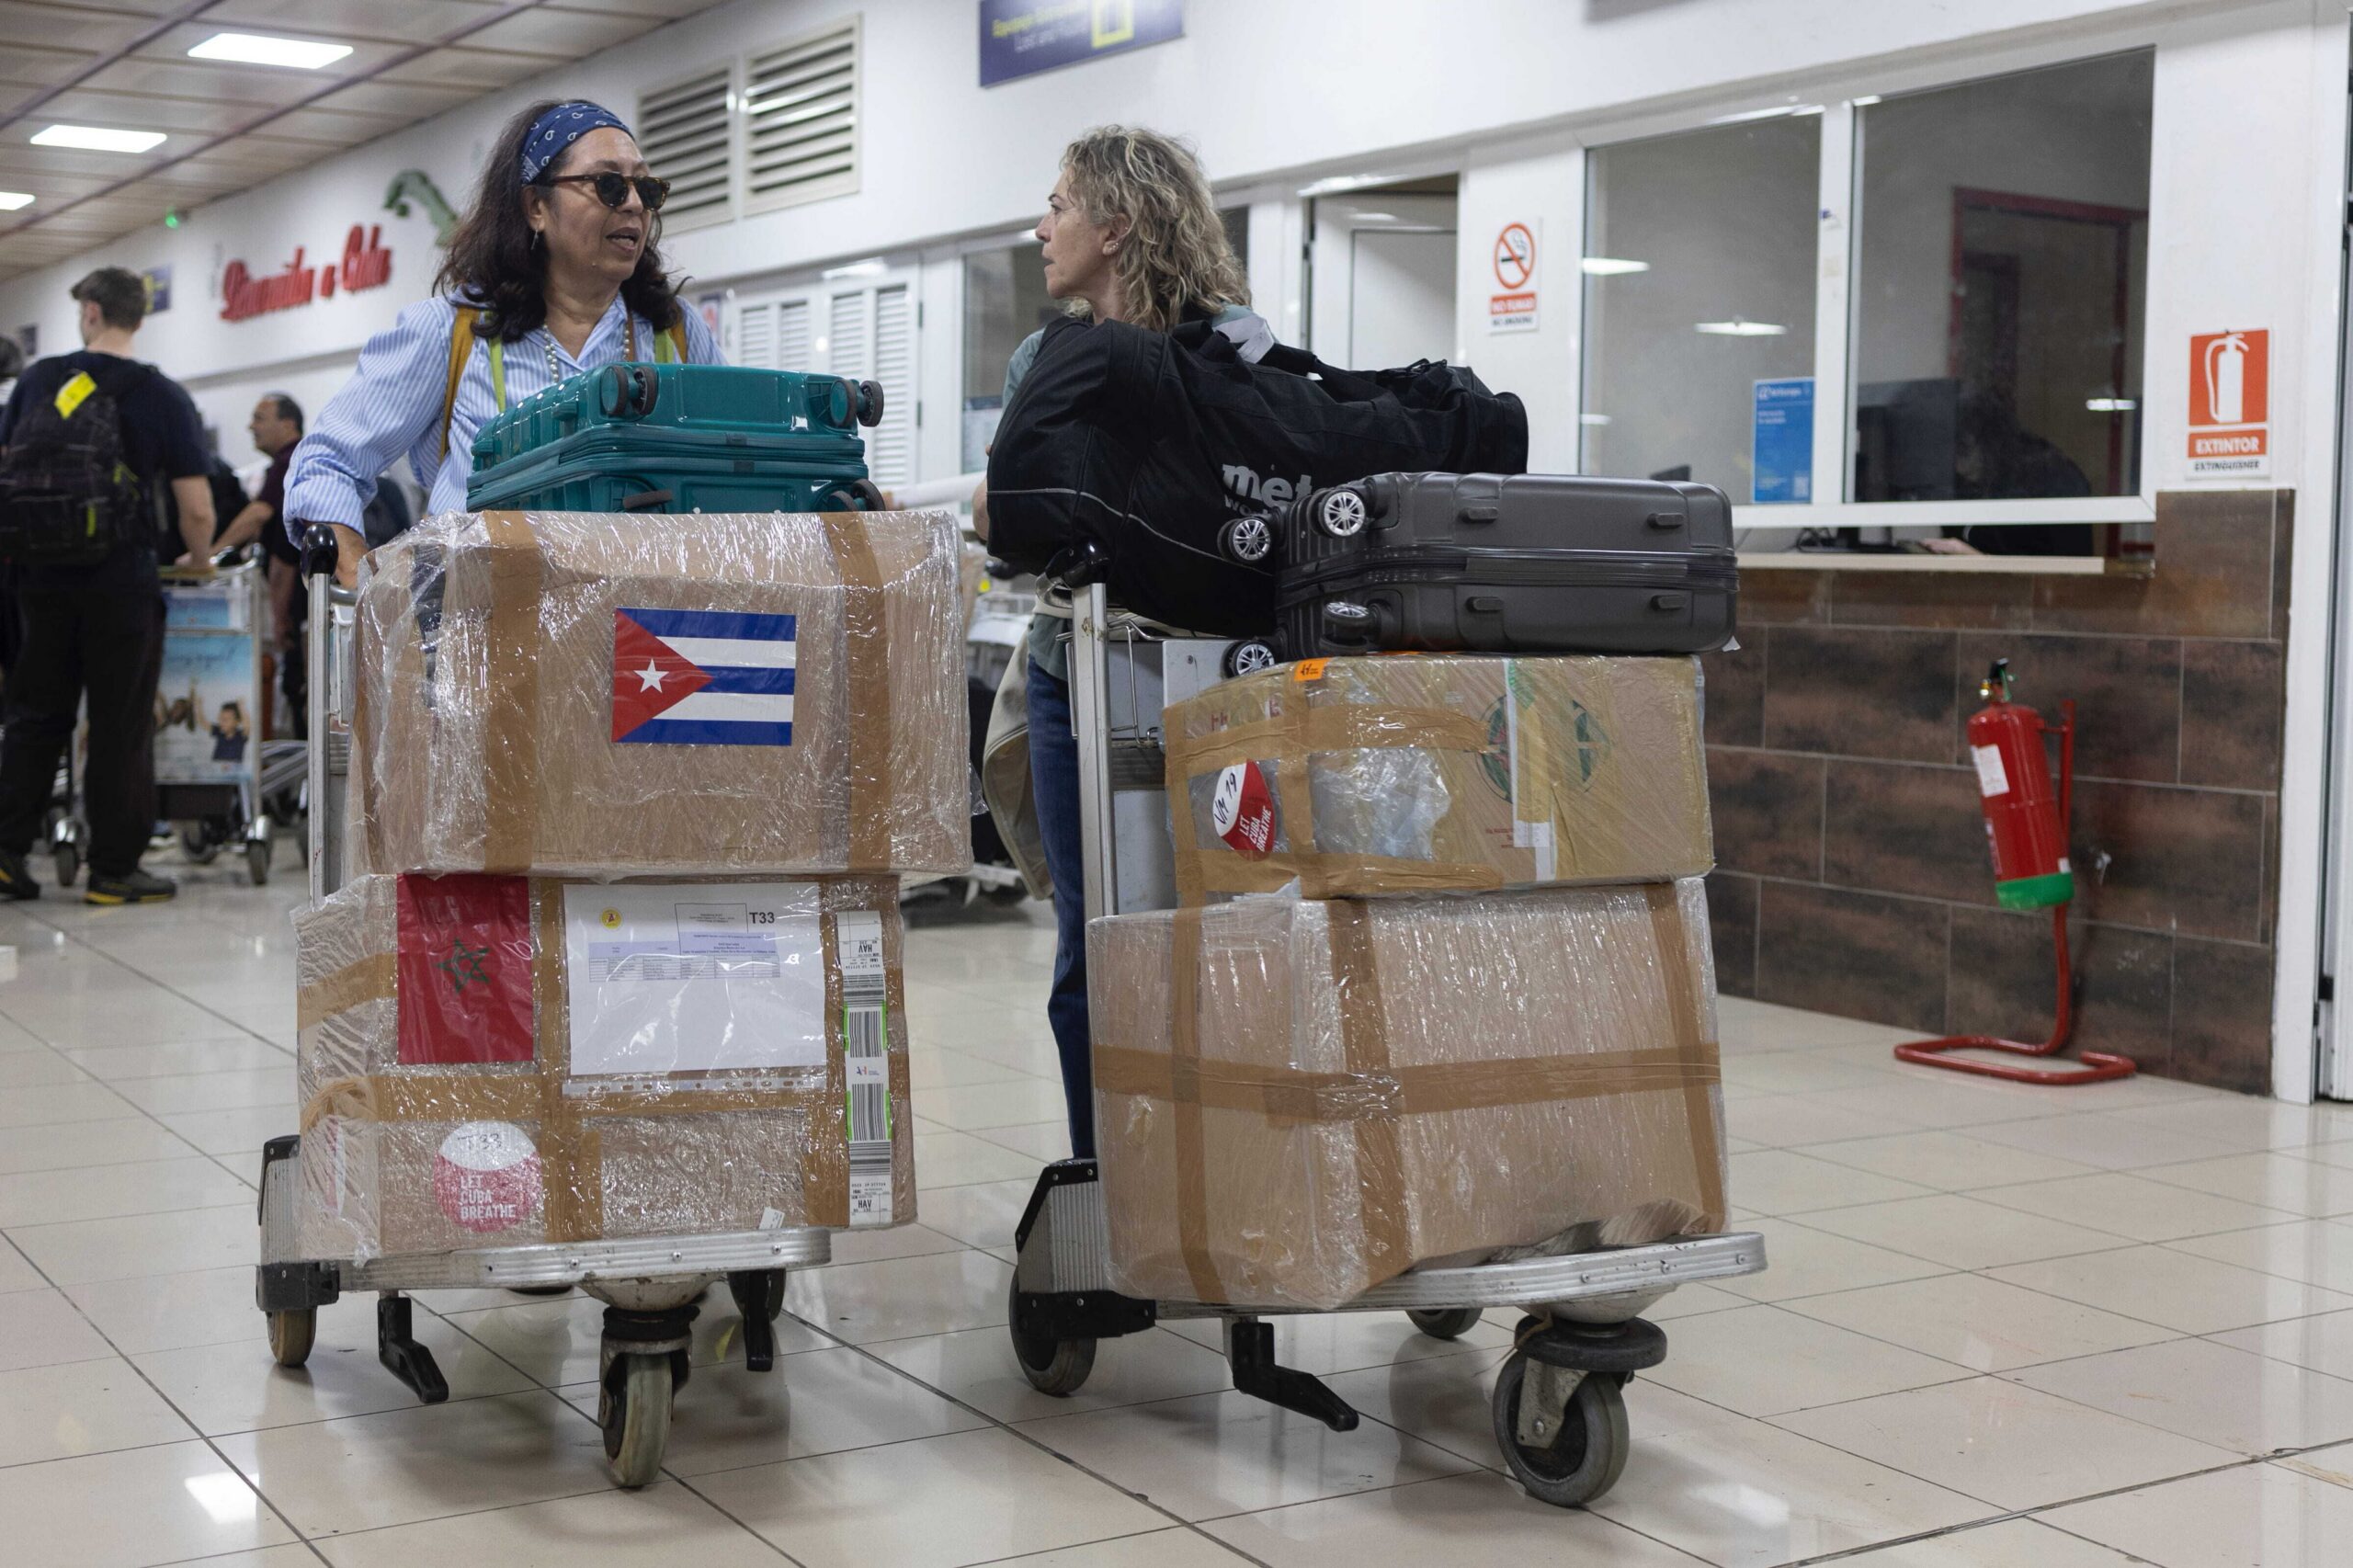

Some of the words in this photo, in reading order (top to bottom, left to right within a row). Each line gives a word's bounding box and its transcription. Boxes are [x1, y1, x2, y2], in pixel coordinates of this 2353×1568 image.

[2196, 437, 2259, 454] EXTINTOR
[1238, 814, 1250, 836] LET
[1249, 816, 1261, 845] CUBA
[1256, 805, 1272, 852] BREATHE
[749, 912, 775, 924] T33
[460, 1175, 483, 1189] LET
[460, 1189, 494, 1205] CUBA
[858, 1199, 872, 1209] HAV
[460, 1204, 517, 1221] BREATHE
